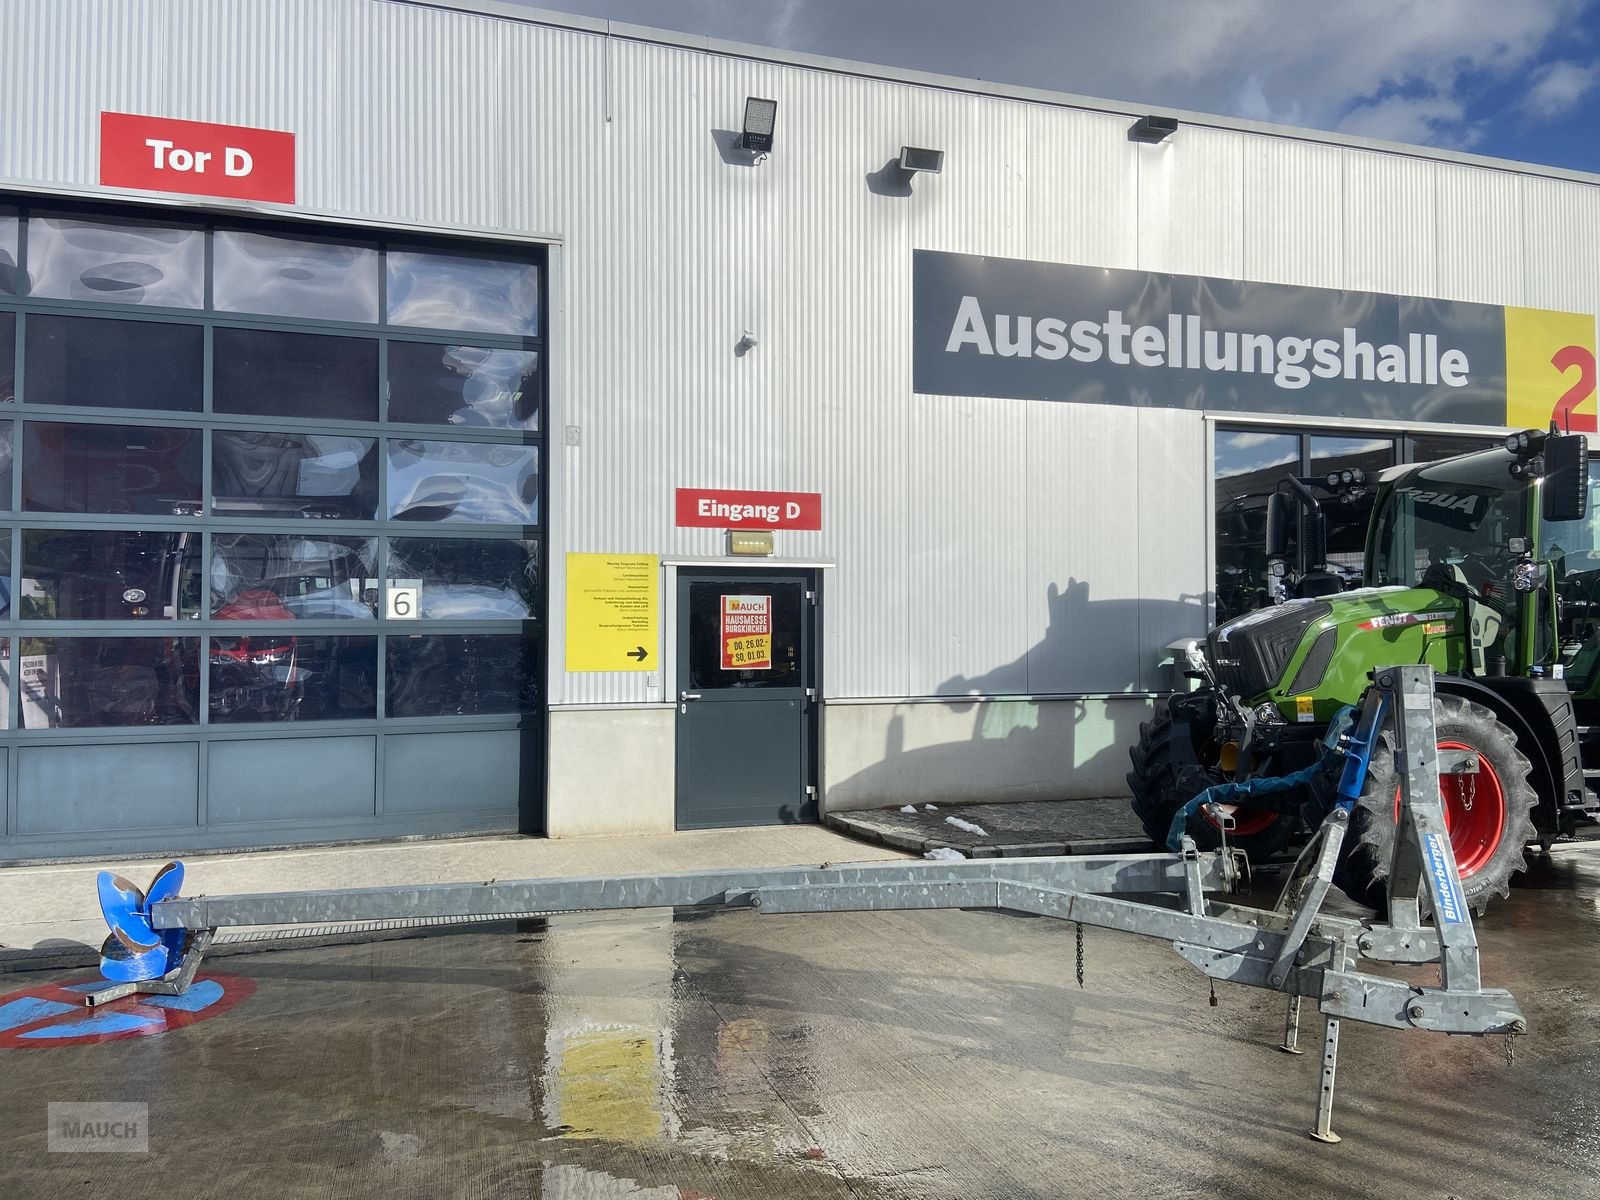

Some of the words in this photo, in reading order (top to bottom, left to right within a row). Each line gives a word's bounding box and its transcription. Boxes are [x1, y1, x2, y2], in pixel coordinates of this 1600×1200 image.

[145, 138, 211, 174] Tor
[224, 147, 253, 177] D
[945, 295, 1470, 389] Ausstellungshalle
[1550, 345, 1597, 432] 2
[698, 498, 780, 523] Eingang
[786, 502, 801, 519] D
[394, 592, 411, 616] 6
[731, 602, 764, 611] MAUCH
[725, 615, 767, 625] HAUSMESSE
[725, 624, 767, 633] BURGKIRCHEN
[1370, 613, 1409, 628] FENDT
[1428, 835, 1457, 920] Binderberger
